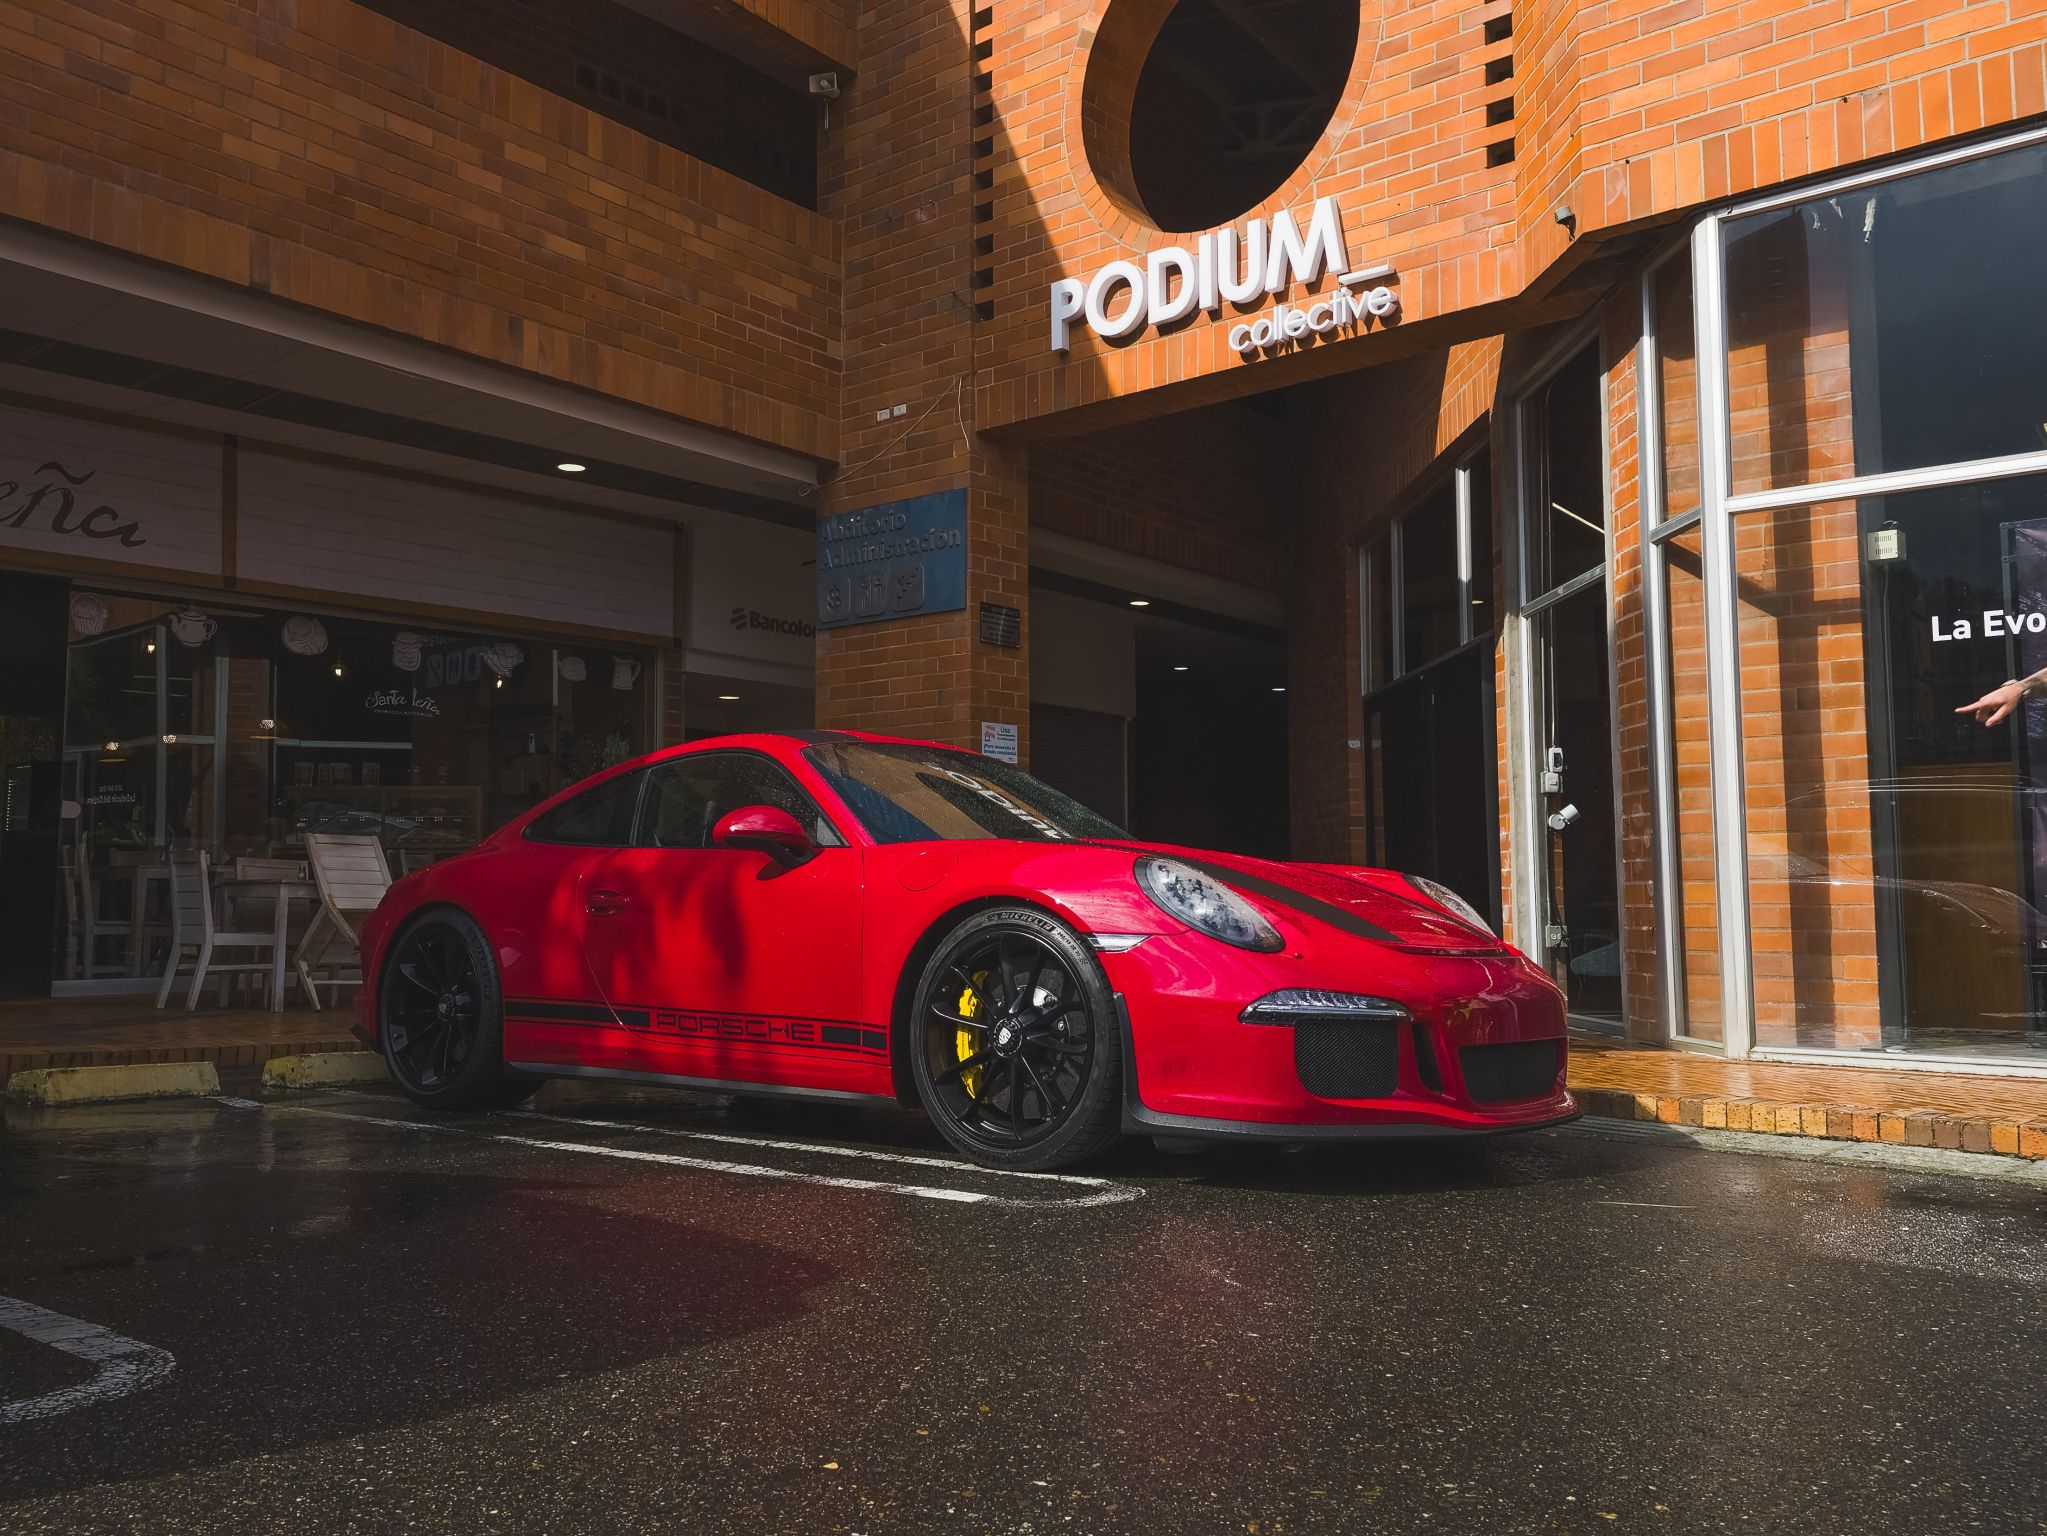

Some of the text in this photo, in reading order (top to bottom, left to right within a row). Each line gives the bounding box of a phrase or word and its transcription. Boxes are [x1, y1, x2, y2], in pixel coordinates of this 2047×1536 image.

[1228, 286, 1398, 353] collective
[820, 509, 906, 545] Auditorio
[749, 610, 816, 639] Bancolo
[1931, 609, 2047, 642] La Evo
[656, 1012, 815, 1042] PORSCHE
